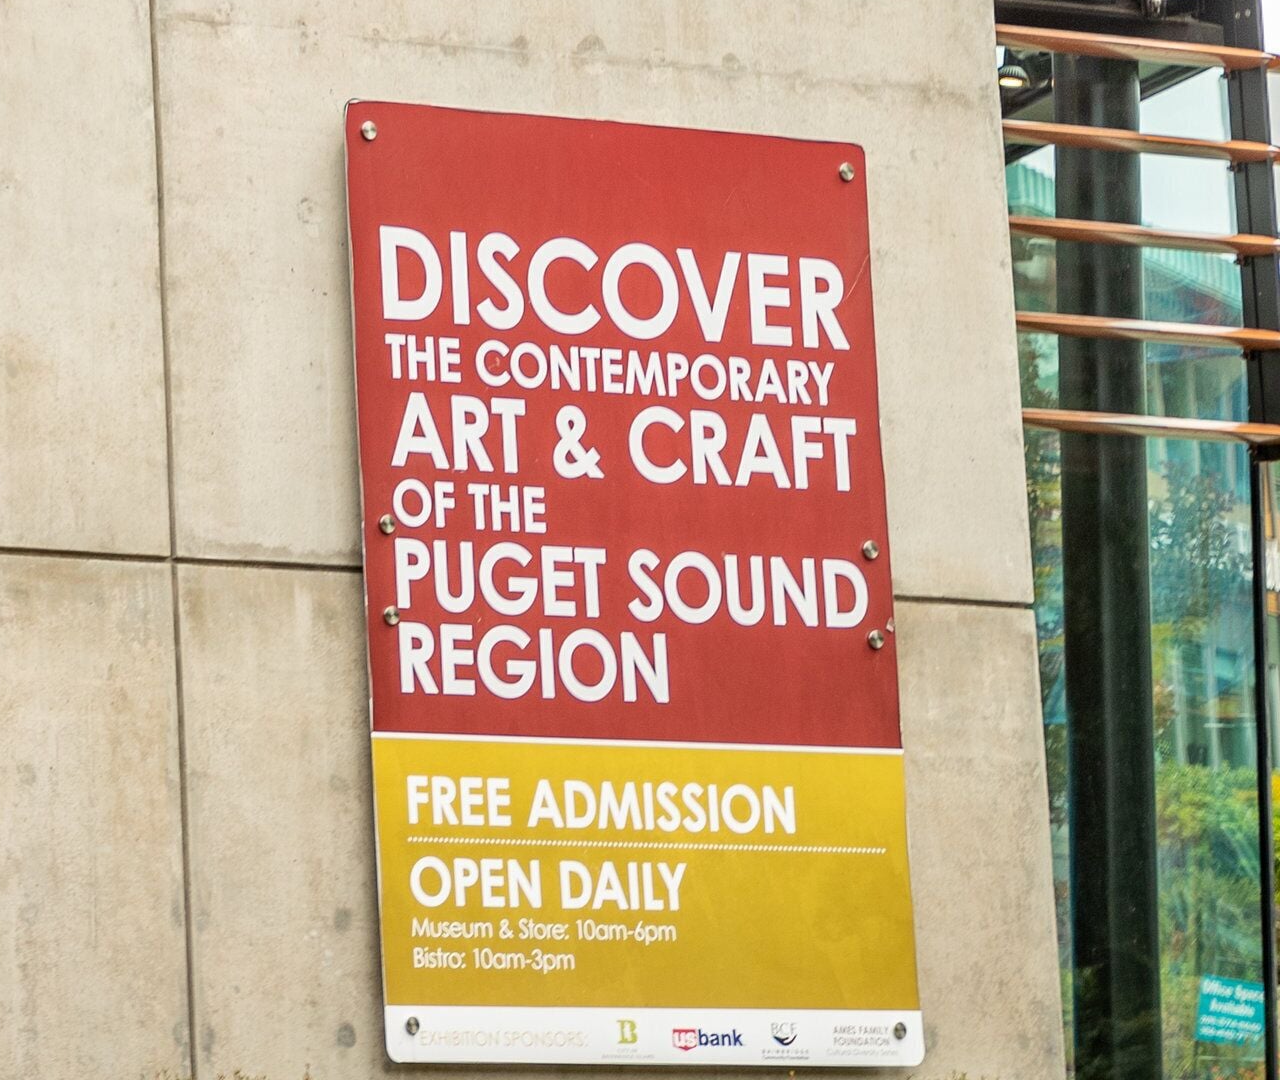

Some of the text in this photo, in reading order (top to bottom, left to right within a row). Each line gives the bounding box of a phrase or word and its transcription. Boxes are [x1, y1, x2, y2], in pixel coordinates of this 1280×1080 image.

[379, 224, 851, 351] DISCOVER
[385, 333, 835, 406] THE CONTEMPORARY
[391, 392, 857, 492] ART & CRAFT
[392, 478, 547, 534] OF THE
[394, 536, 869, 628] PUGET SOUND
[398, 621, 670, 703] REGION
[406, 775, 797, 835] FREE ADMISSION
[409, 855, 688, 912] OPEN DAILY
[411, 917, 677, 946] Museum & Store: 10am-6pm
[412, 947, 576, 974] Bistro: 10am-3pm
